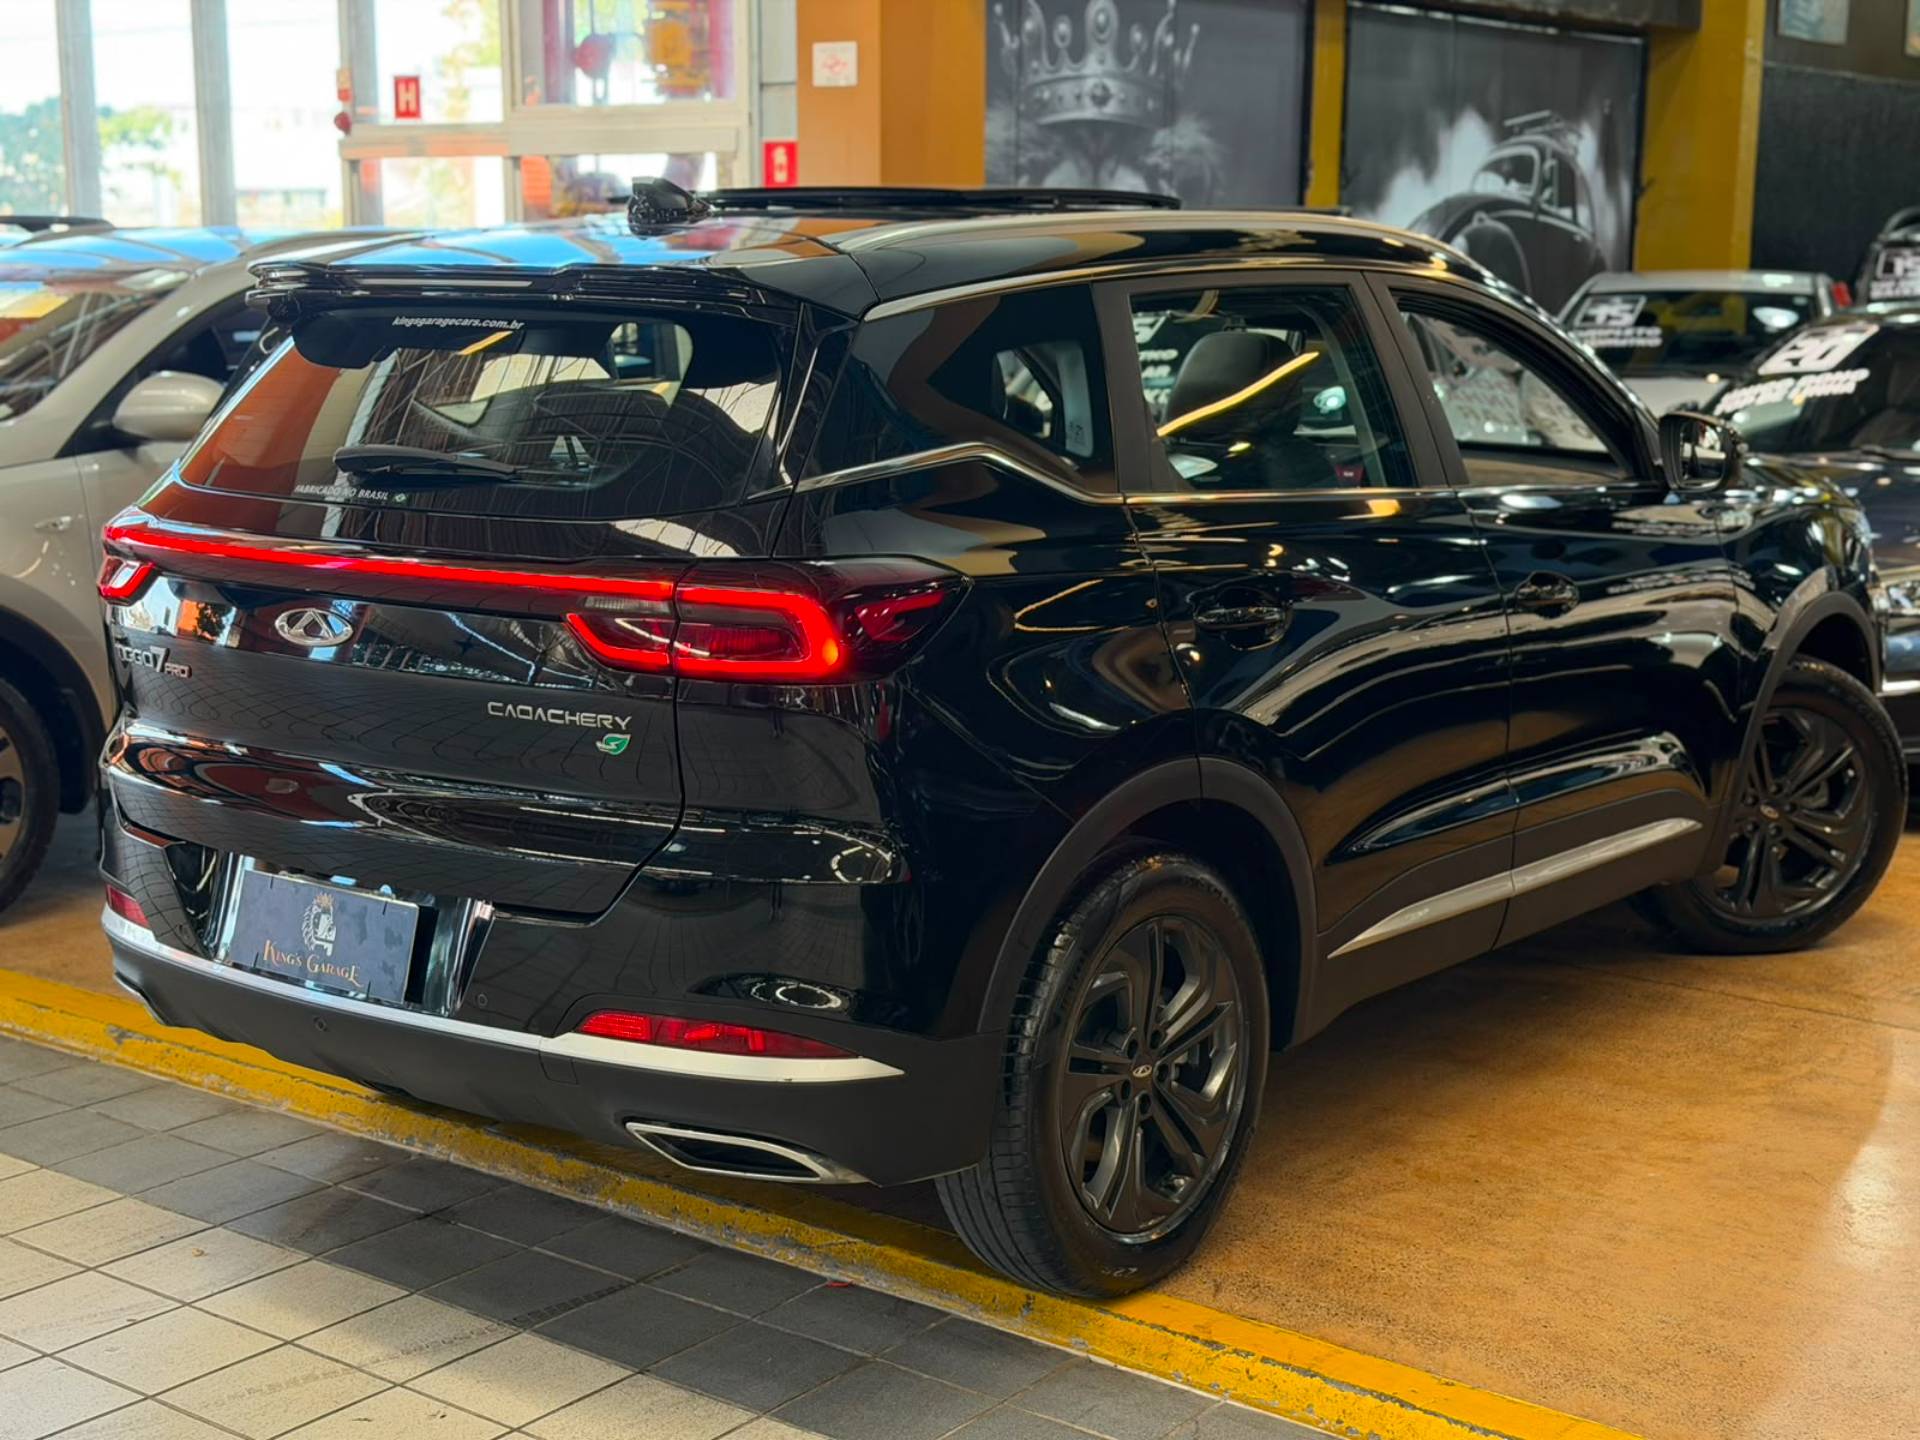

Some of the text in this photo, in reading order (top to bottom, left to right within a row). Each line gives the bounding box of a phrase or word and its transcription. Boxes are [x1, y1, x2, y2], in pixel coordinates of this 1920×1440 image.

[392, 316, 525, 330] kingsgaragecars.com.br
[358, 489, 388, 500] BRASIL
[164, 662, 190, 678] PRO
